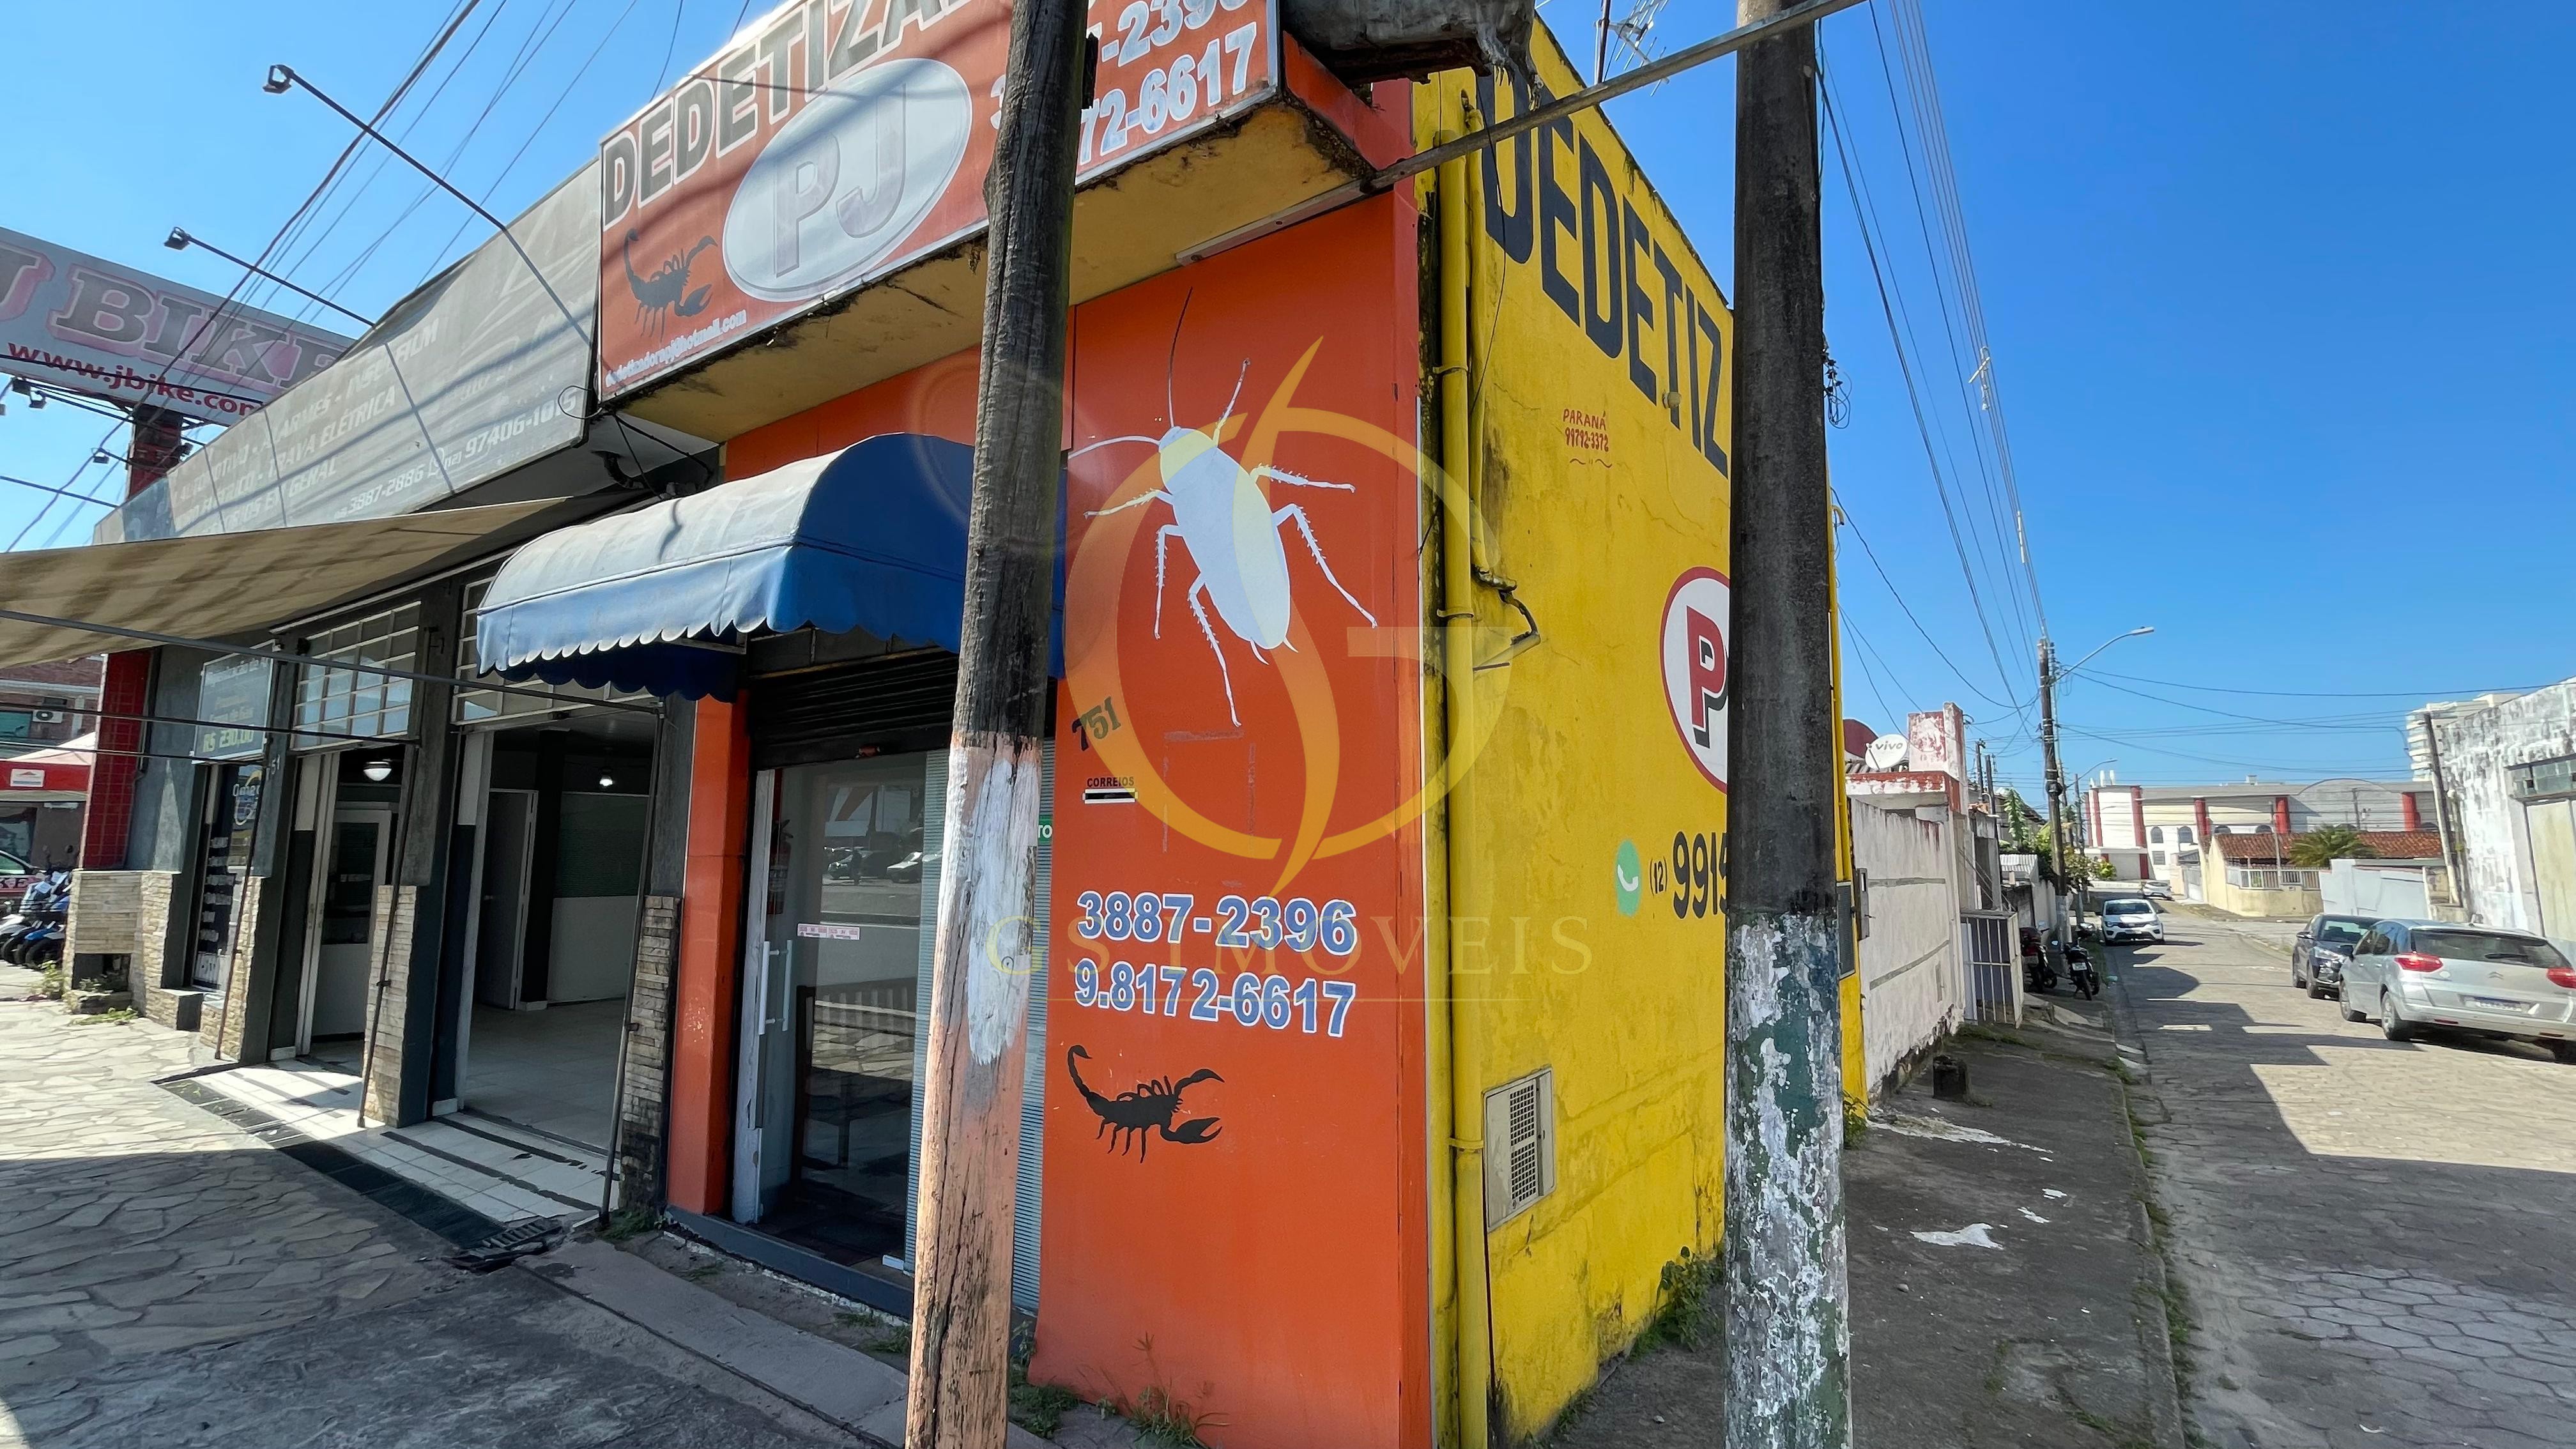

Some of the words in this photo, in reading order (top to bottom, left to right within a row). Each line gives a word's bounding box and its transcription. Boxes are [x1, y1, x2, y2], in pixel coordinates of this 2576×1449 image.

[774, 84, 907, 277] PJ
[1563, 408, 1606, 431] PARANÁ
[1071, 696, 1121, 751] 751
[1875, 741, 1903, 751] vivo
[1087, 776, 1135, 788] CORREIOS
[1673, 831, 1726, 919] 991
[1076, 890, 1358, 956] 3887-2396
[1073, 958, 1357, 1039] 9.8172-6617
